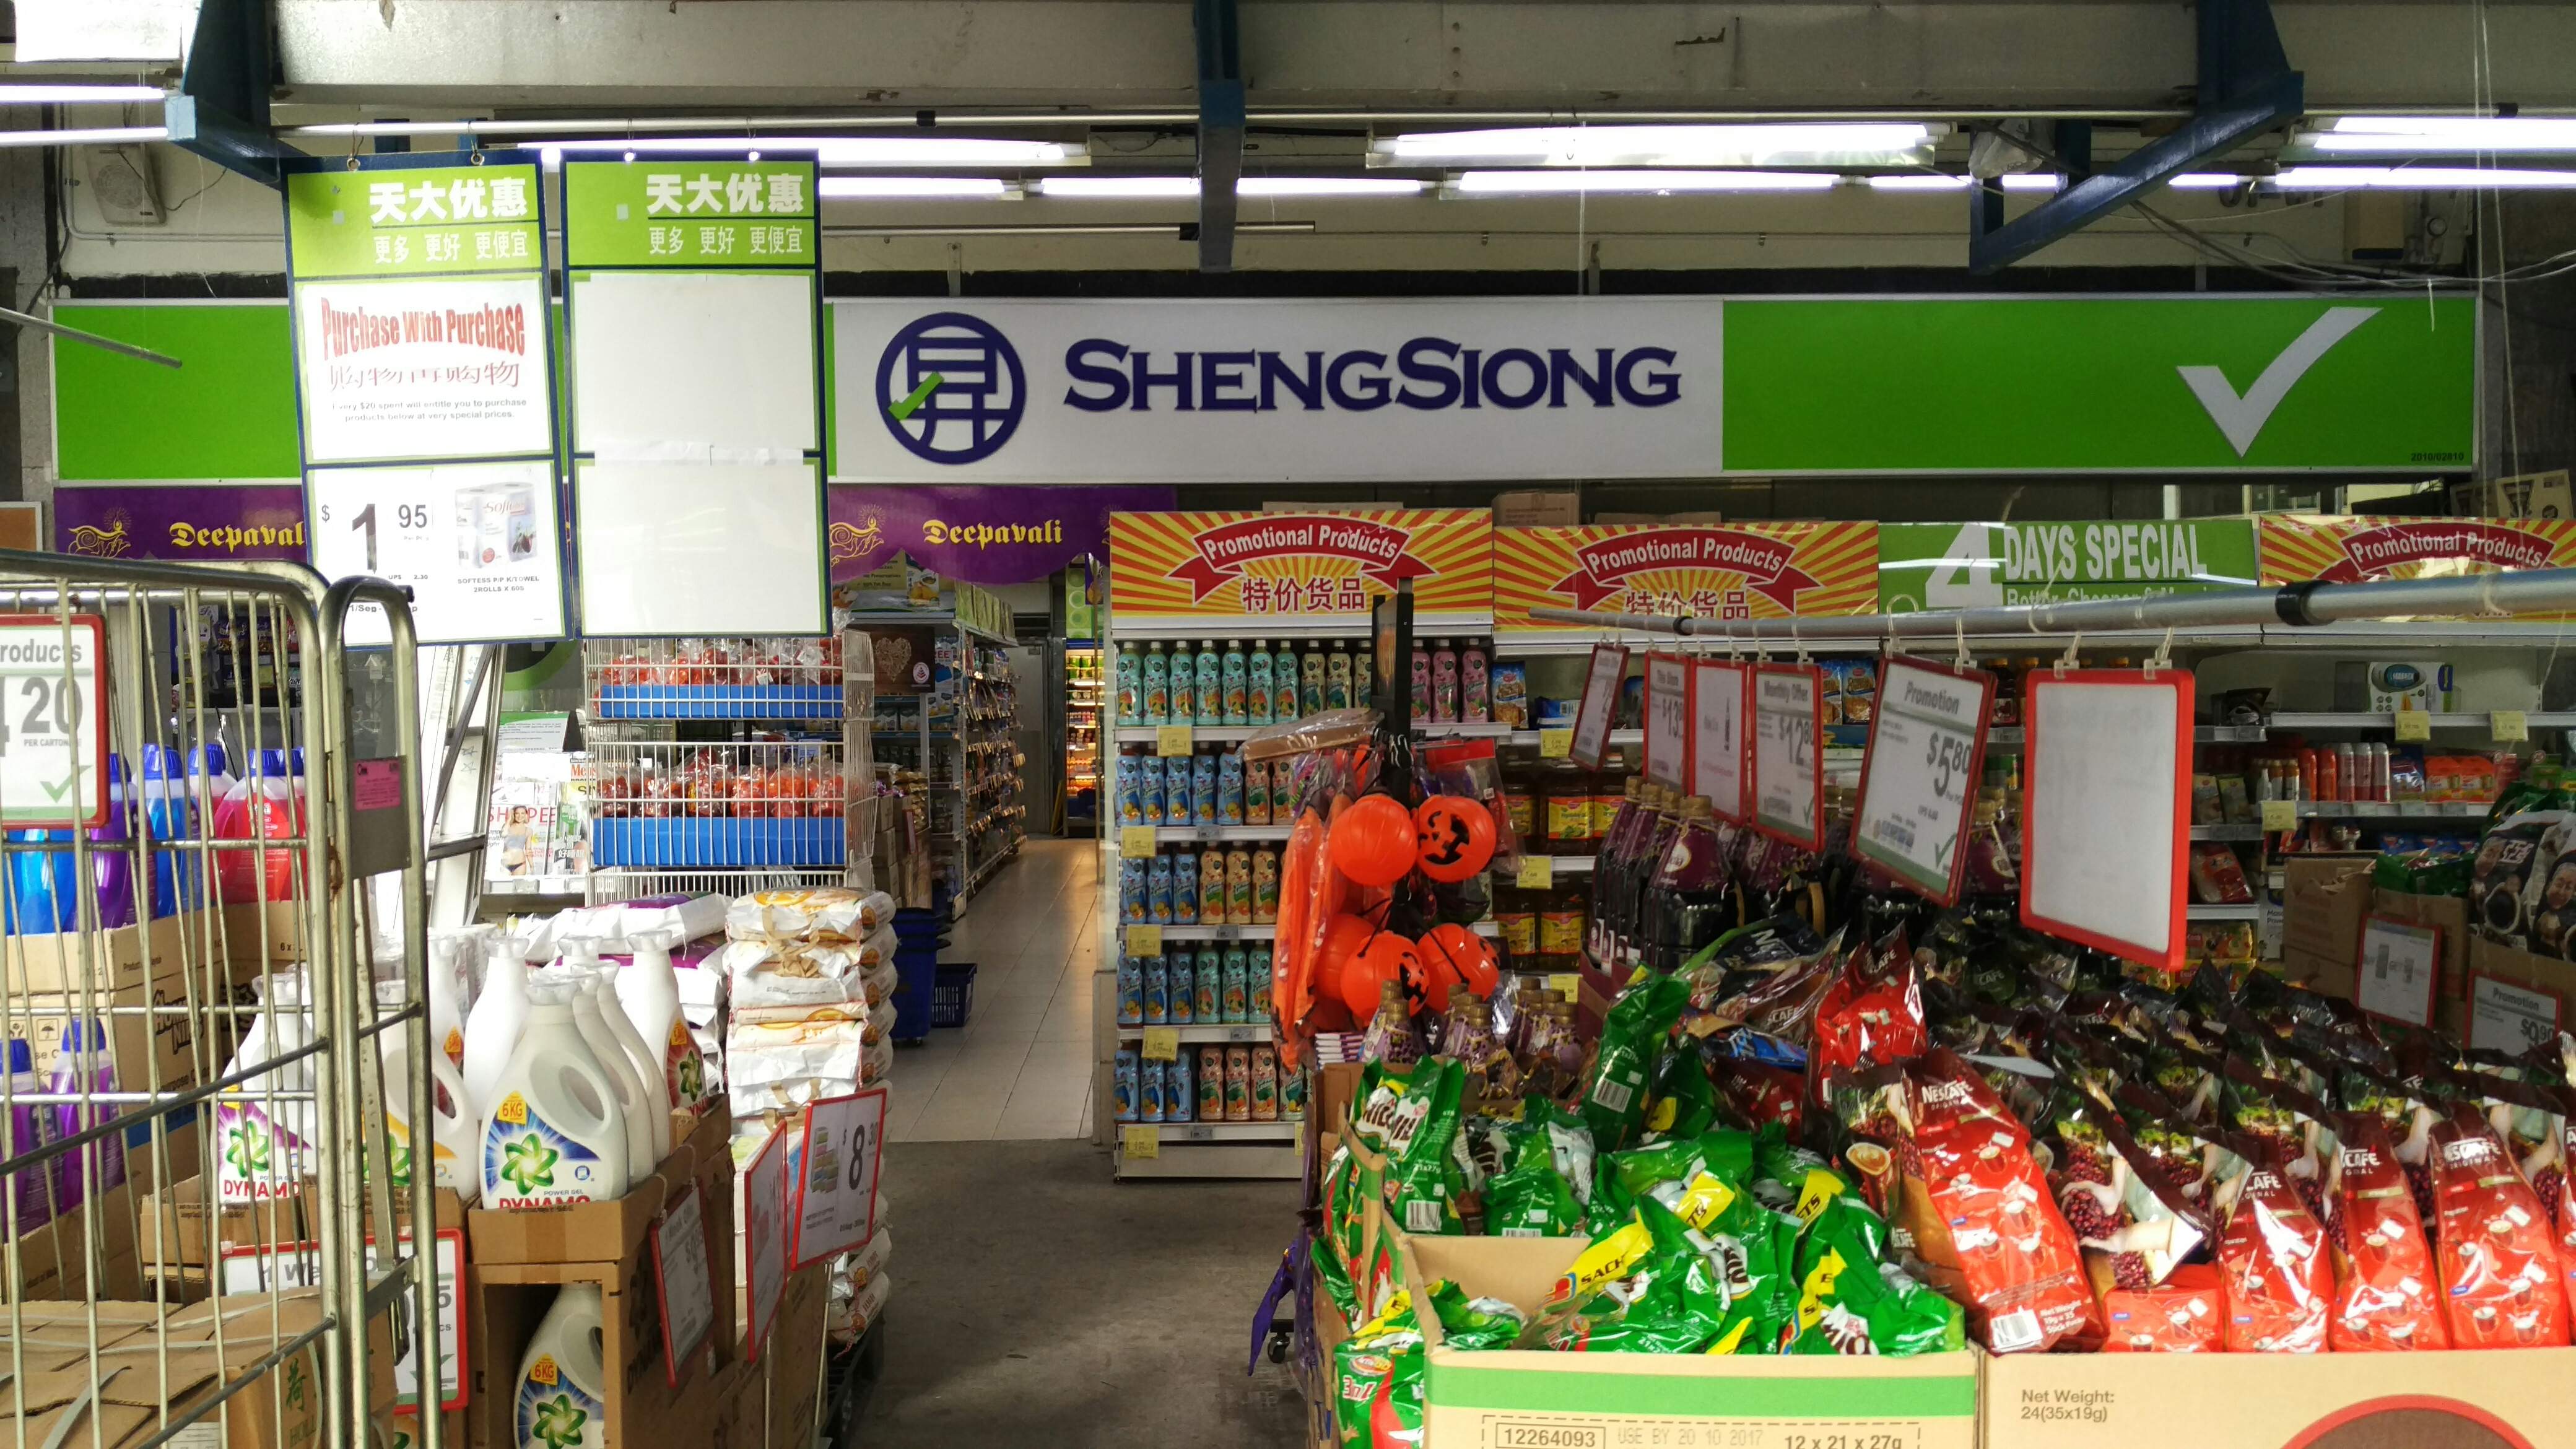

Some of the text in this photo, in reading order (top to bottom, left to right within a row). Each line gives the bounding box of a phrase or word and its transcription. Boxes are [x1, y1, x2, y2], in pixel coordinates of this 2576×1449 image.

[370, 176, 528, 224] 天大优惠
[646, 173, 804, 214] 天大优惠
[373, 229, 528, 264] 更多 更好 更便宜
[649, 225, 803, 255] 更多 更好 更便宜
[321, 297, 525, 361] Purchase With Purchase
[333, 402, 357, 411] very
[485, 398, 526, 409] purchase
[170, 521, 305, 553] Deepaval
[321, 504, 330, 523] $
[352, 504, 377, 573] 1
[398, 504, 428, 528] 95
[923, 519, 1063, 550] Deepavali
[1203, 523, 1398, 560] Promotional Products
[2352, 531, 2544, 567] Promotional Products
[1587, 537, 1783, 573] Promotional Products
[1925, 523, 2003, 607] 4
[2003, 524, 2208, 580] DAYS SPECIAL
[1242, 577, 1365, 612] 特价货品
[0, 638, 82, 663] roducs
[1904, 682, 1960, 715] Promotion
[2492, 987, 2539, 1011] Promotion
[849, 1125, 865, 1190] 8
[2022, 1389, 2115, 1407] Net Weight:
[2022, 1406, 2107, 1423] 24(35x19g)
[1504, 1429, 1596, 1448] 12264093
[1617, 1429, 1763, 1445] USE BY 20 10 2017
[1785, 1435, 1804, 1449] 12
[1827, 1435, 1847, 1449] 21
